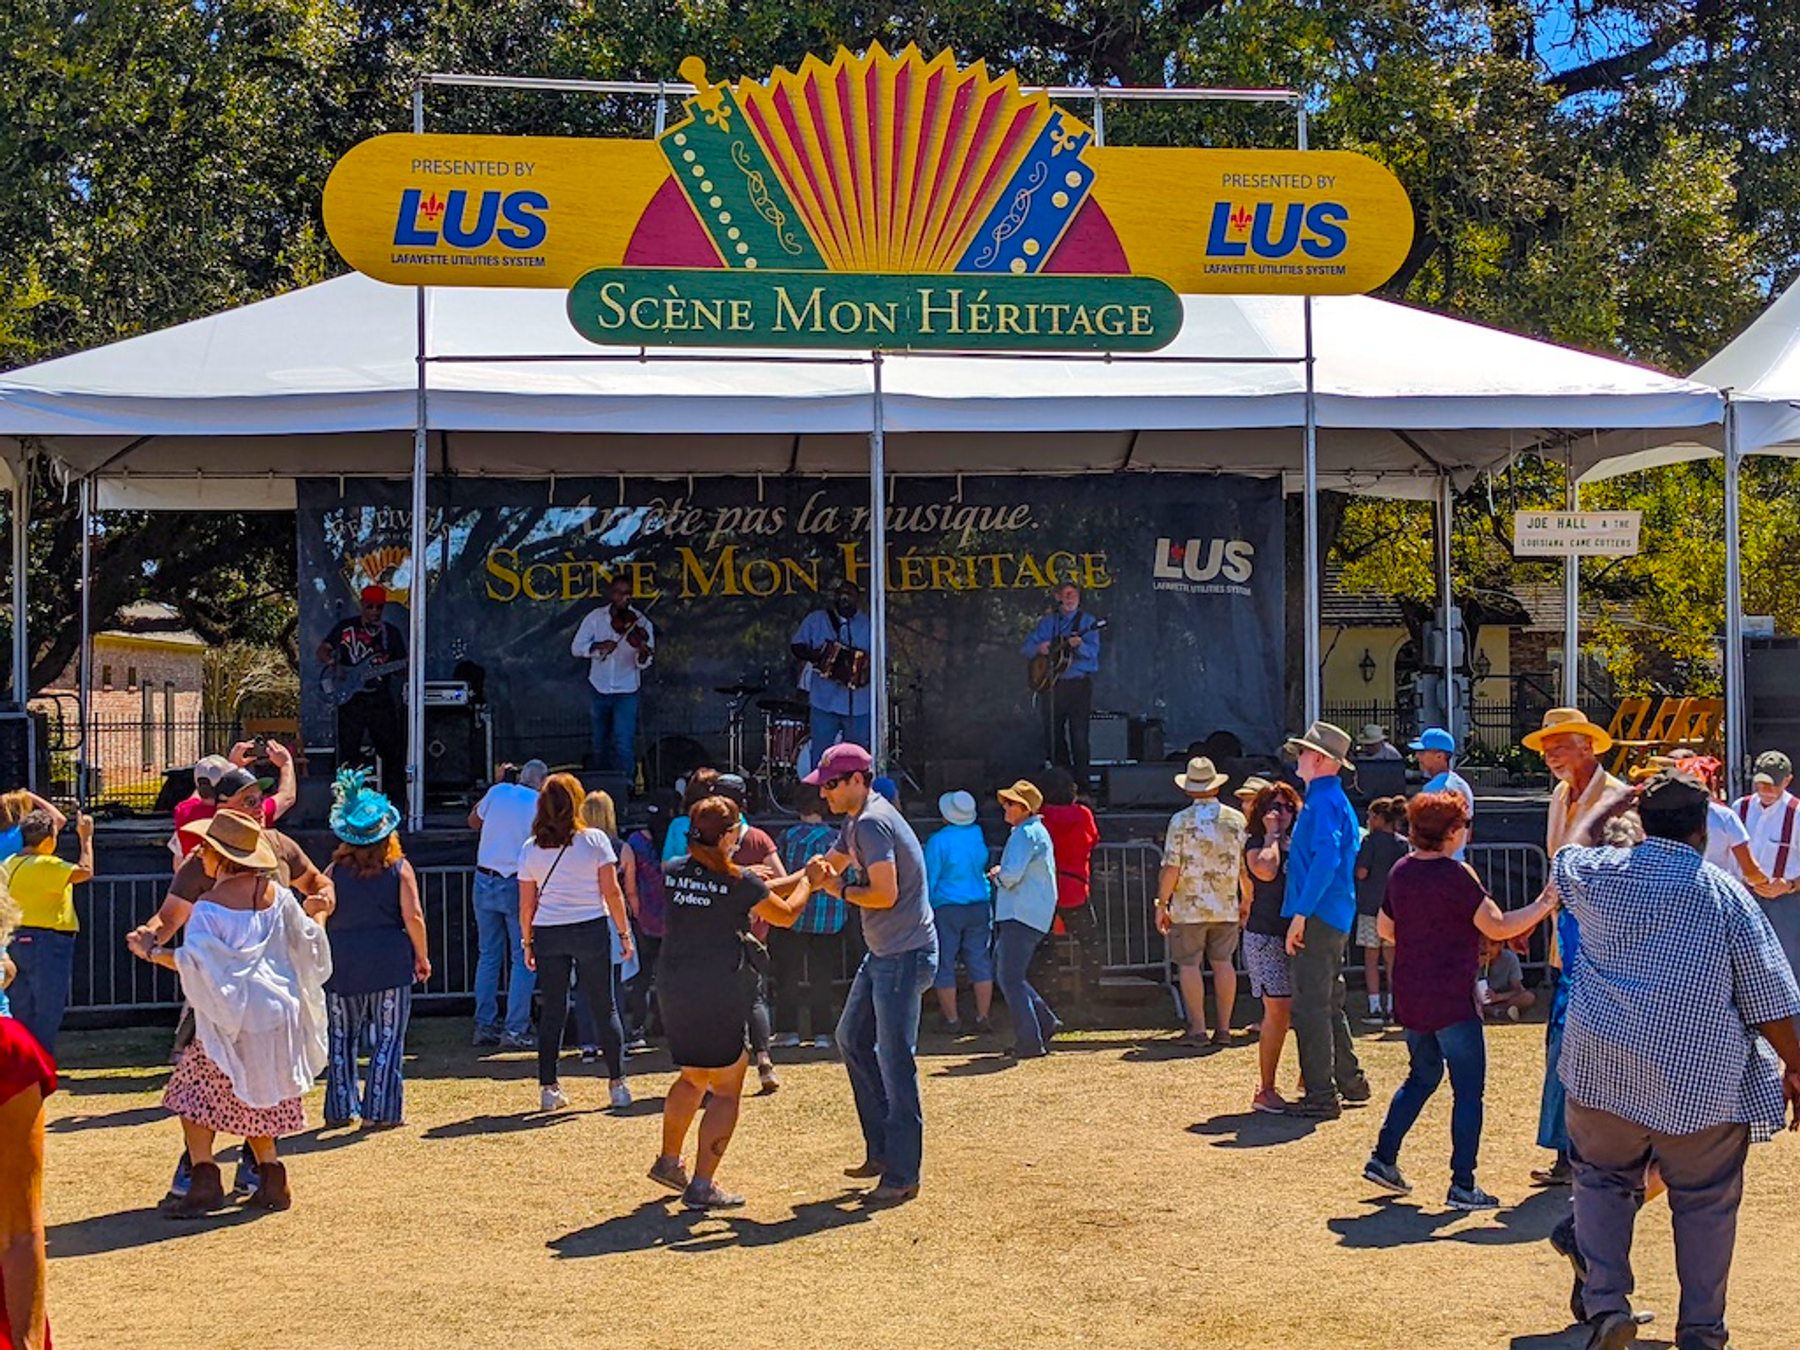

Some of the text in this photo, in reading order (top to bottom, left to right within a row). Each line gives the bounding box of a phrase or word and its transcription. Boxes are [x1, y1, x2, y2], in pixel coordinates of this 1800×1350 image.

[411, 158, 536, 178] PRESENTED BY
[1222, 173, 1337, 190] PRESENTED BY
[393, 188, 549, 250] LUS
[1205, 201, 1349, 259] LUS
[391, 253, 546, 268] LAFAYETTE UTILITIES SYSTEM
[1203, 263, 1346, 276] LAFAYETTE UTILITIES SYSTEM
[597, 282, 1155, 337] SCÈNE MON HÉRITAGE
[331, 510, 451, 541] FETIVLS
[705, 505, 785, 553] pas
[796, 490, 840, 534] la
[849, 494, 1040, 547] musique.
[1526, 516, 1548, 529] JOE
[1557, 517, 1587, 529] HALL
[1614, 519, 1630, 528] THE
[1520, 537, 1632, 548] LOUISIANA CANE CUTTERS
[485, 541, 1113, 601] SCÈNE MON HÉRITAGE
[1153, 537, 1255, 583] LUS
[673, 891, 711, 907] Zydeco
